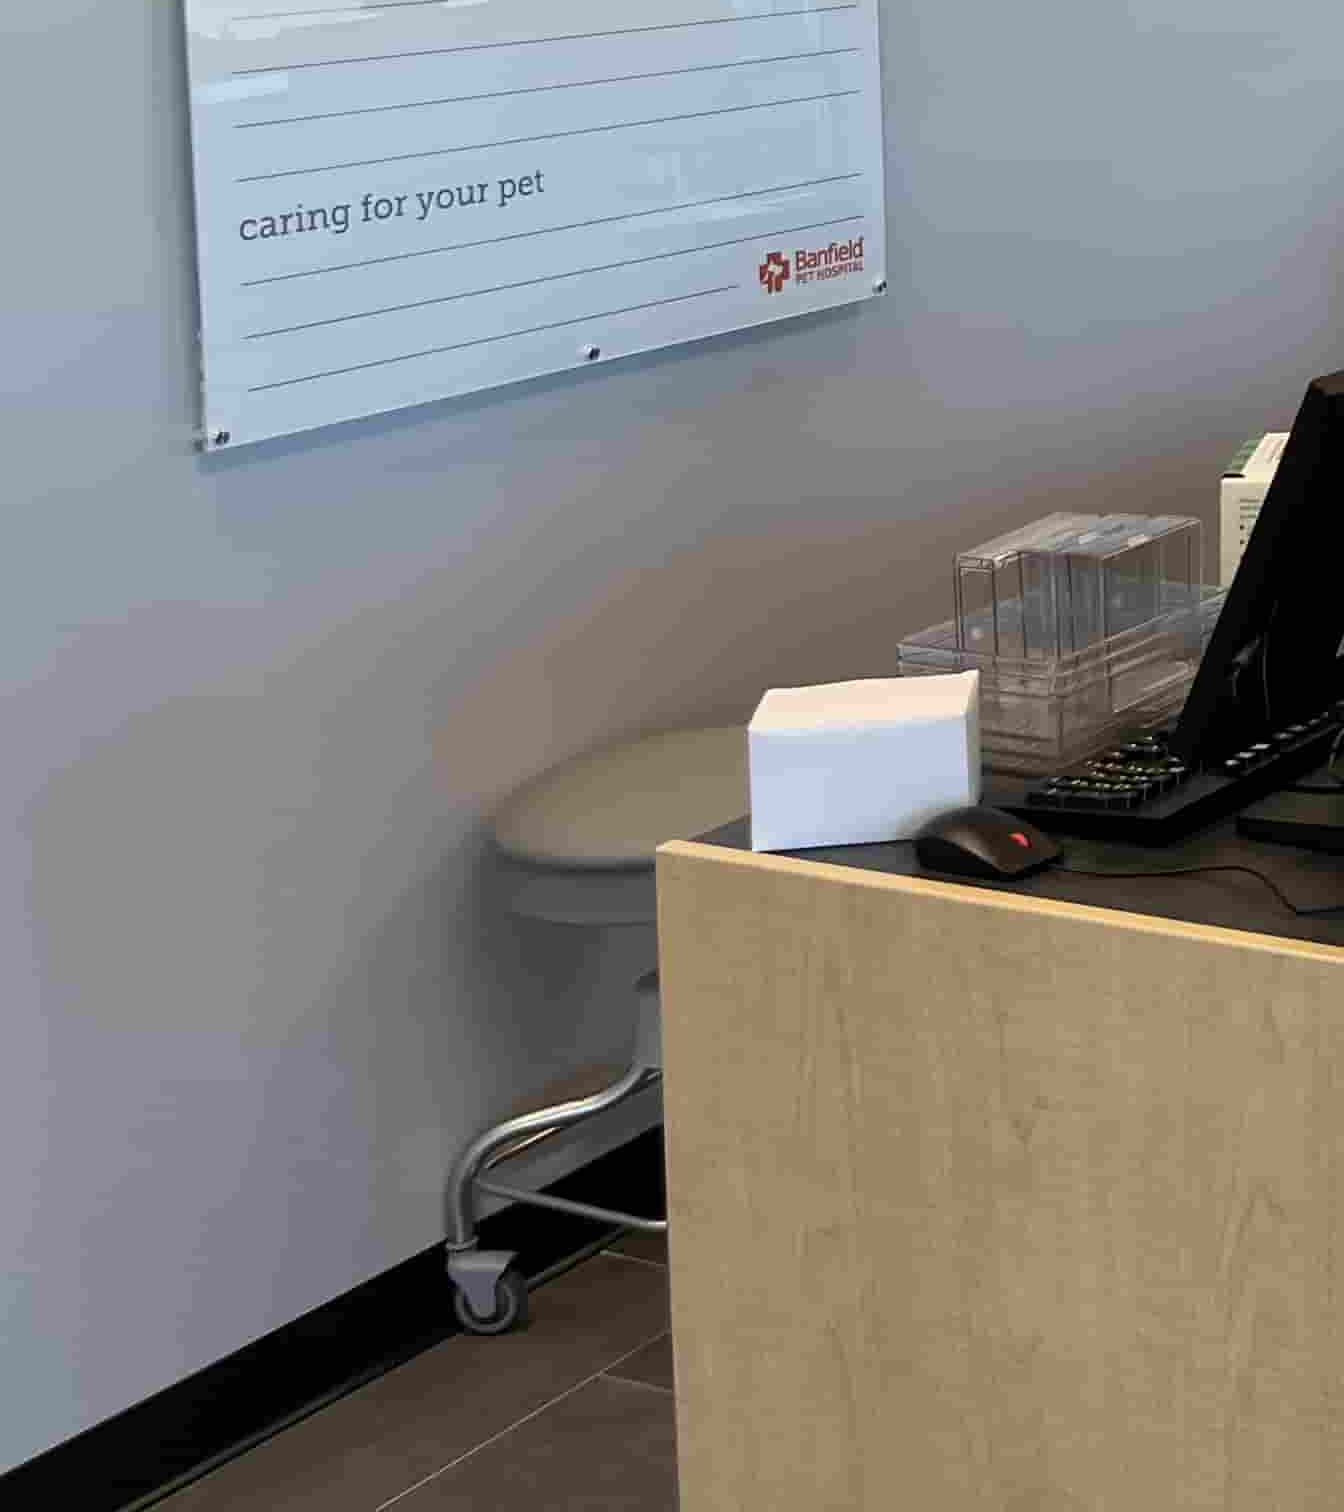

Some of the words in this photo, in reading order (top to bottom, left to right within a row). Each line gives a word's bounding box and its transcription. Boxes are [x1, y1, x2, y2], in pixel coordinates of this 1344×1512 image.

[239, 203, 352, 240] caring
[360, 193, 408, 222] for
[416, 183, 489, 220] your
[497, 169, 544, 207] pet
[795, 236, 864, 271] Banfield
